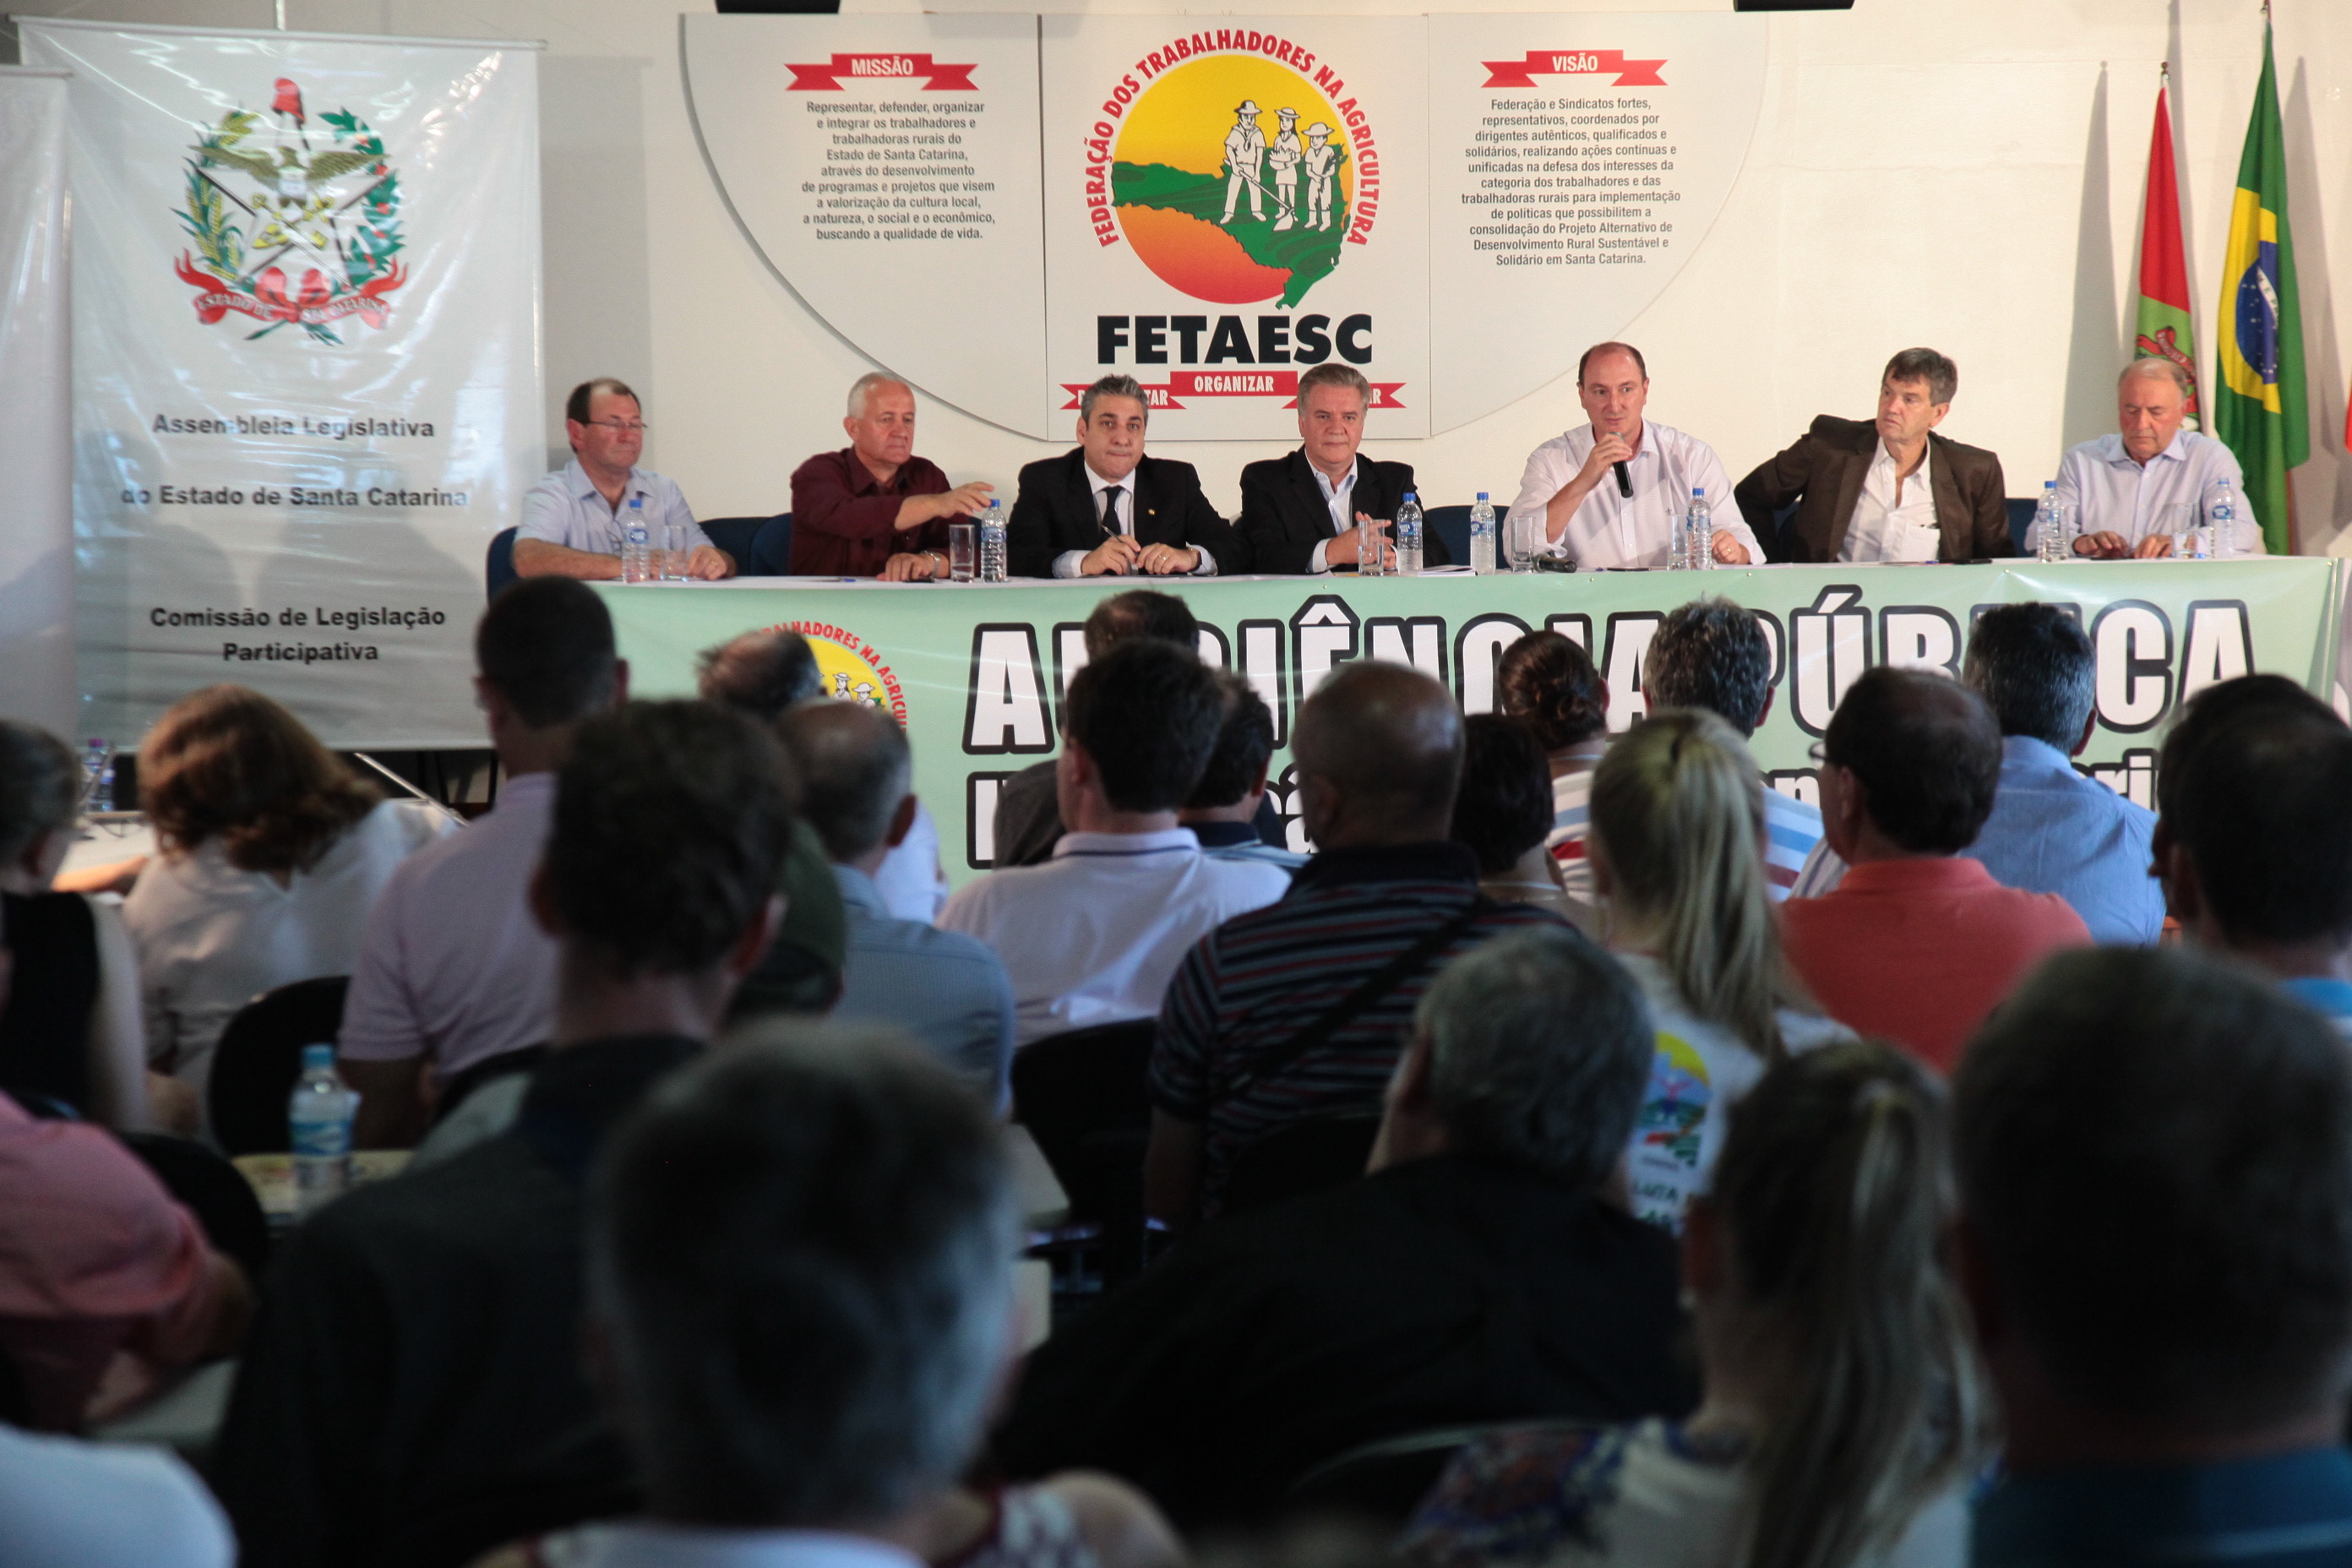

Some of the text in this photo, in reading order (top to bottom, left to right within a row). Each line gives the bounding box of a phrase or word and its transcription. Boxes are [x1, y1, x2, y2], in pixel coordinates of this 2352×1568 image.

[851, 55, 914, 76] MISSÃO
[1552, 52, 1598, 72] VISÃO
[806, 101, 985, 114] Representar, defender, organizar
[1491, 97, 1652, 112] Federação e Sindicatos fortes,
[816, 117, 977, 131] e integrar os trabalhadores e
[1482, 113, 1660, 128] representativos, coordenados por
[832, 133, 962, 144] trabalhadoras rurais do
[1083, 29, 1380, 248] FEDERAÇÃO DOS TRABALHADORES NA AGRICULTURA
[1474, 128, 1667, 144] dirigentes autênticos, qualificados e
[826, 149, 968, 161] Estado de Santa Catarina,
[1465, 145, 1521, 159] solidários,
[1522, 145, 1579, 156] realizando
[1581, 145, 1613, 159] ações
[1614, 144, 1668, 155] contínuas
[820, 165, 975, 177] através do desenvolvimento
[1467, 160, 1674, 173] unificadas na defesa dos interesses da
[801, 182, 815, 192] de
[818, 182, 879, 194] programas
[890, 181, 936, 194] projetos
[939, 181, 960, 193] que
[961, 180, 995, 191] visem
[1480, 176, 1662, 191] categoria dos trabalhadores e das
[816, 196, 981, 210] a valorização da cultura local,
[1461, 190, 1681, 204] trabalhadoras rurais para implementação
[803, 212, 995, 225] a natureza, o social e o econômico,
[1490, 208, 1505, 219] de
[1506, 207, 1553, 221] políticas
[1554, 208, 1575, 220] que
[1577, 206, 1642, 220] possibilitem
[816, 229, 870, 239] buscando
[883, 228, 938, 242] qualidade
[939, 228, 954, 238] de
[956, 227, 983, 238] vida.
[1469, 222, 1673, 238] consolidação do Projeto Alternativo de
[1473, 238, 1565, 251] Desenvolvimento
[1566, 238, 1595, 248] Rural
[1598, 237, 1660, 248] Sustentável
[1495, 253, 1647, 265] Solidário em Santa Catarina.
[1097, 313, 1372, 364] FETAESC
[1194, 375, 1274, 393] ORGANIZAR
[302, 416, 434, 440] Legislativa
[160, 486, 244, 505] Estado
[251, 486, 280, 505] de
[290, 487, 359, 507] Santa
[367, 487, 468, 507] Catarina
[150, 607, 446, 631] Comissão de Legislação
[222, 641, 378, 665] Participativa
[859, 645, 881, 667] NA
